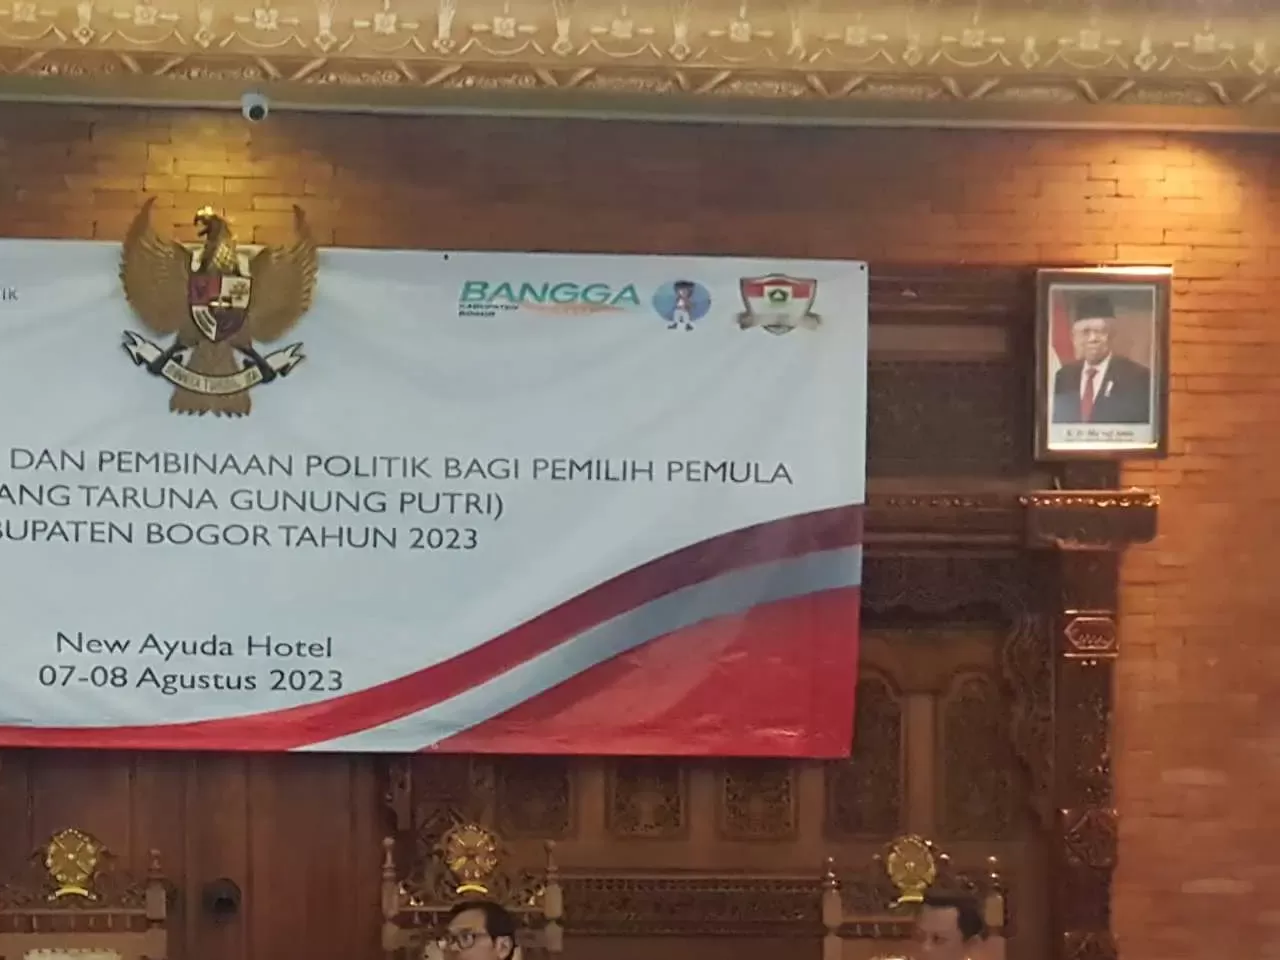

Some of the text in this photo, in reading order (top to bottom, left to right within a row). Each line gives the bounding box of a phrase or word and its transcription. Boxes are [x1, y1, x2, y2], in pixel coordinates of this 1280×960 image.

[459, 280, 641, 305] BANGGA
[10, 447, 85, 472] DAN
[98, 450, 293, 477] PEMBINAAN
[305, 454, 431, 478] POLITIK
[444, 457, 519, 480] BAGI
[532, 458, 654, 482] PEMILIH
[667, 460, 793, 485] PEMULA
[77, 484, 219, 510] TARUNA
[229, 489, 387, 514] GUNUNG
[399, 491, 504, 521] PUTRI)
[146, 522, 271, 547] BOGOR
[278, 525, 397, 549] TAHUN
[409, 527, 478, 550] 2023
[56, 631, 332, 662] New Ayuda Hotel
[38, 664, 343, 696] 07-08 Agustus 2023
